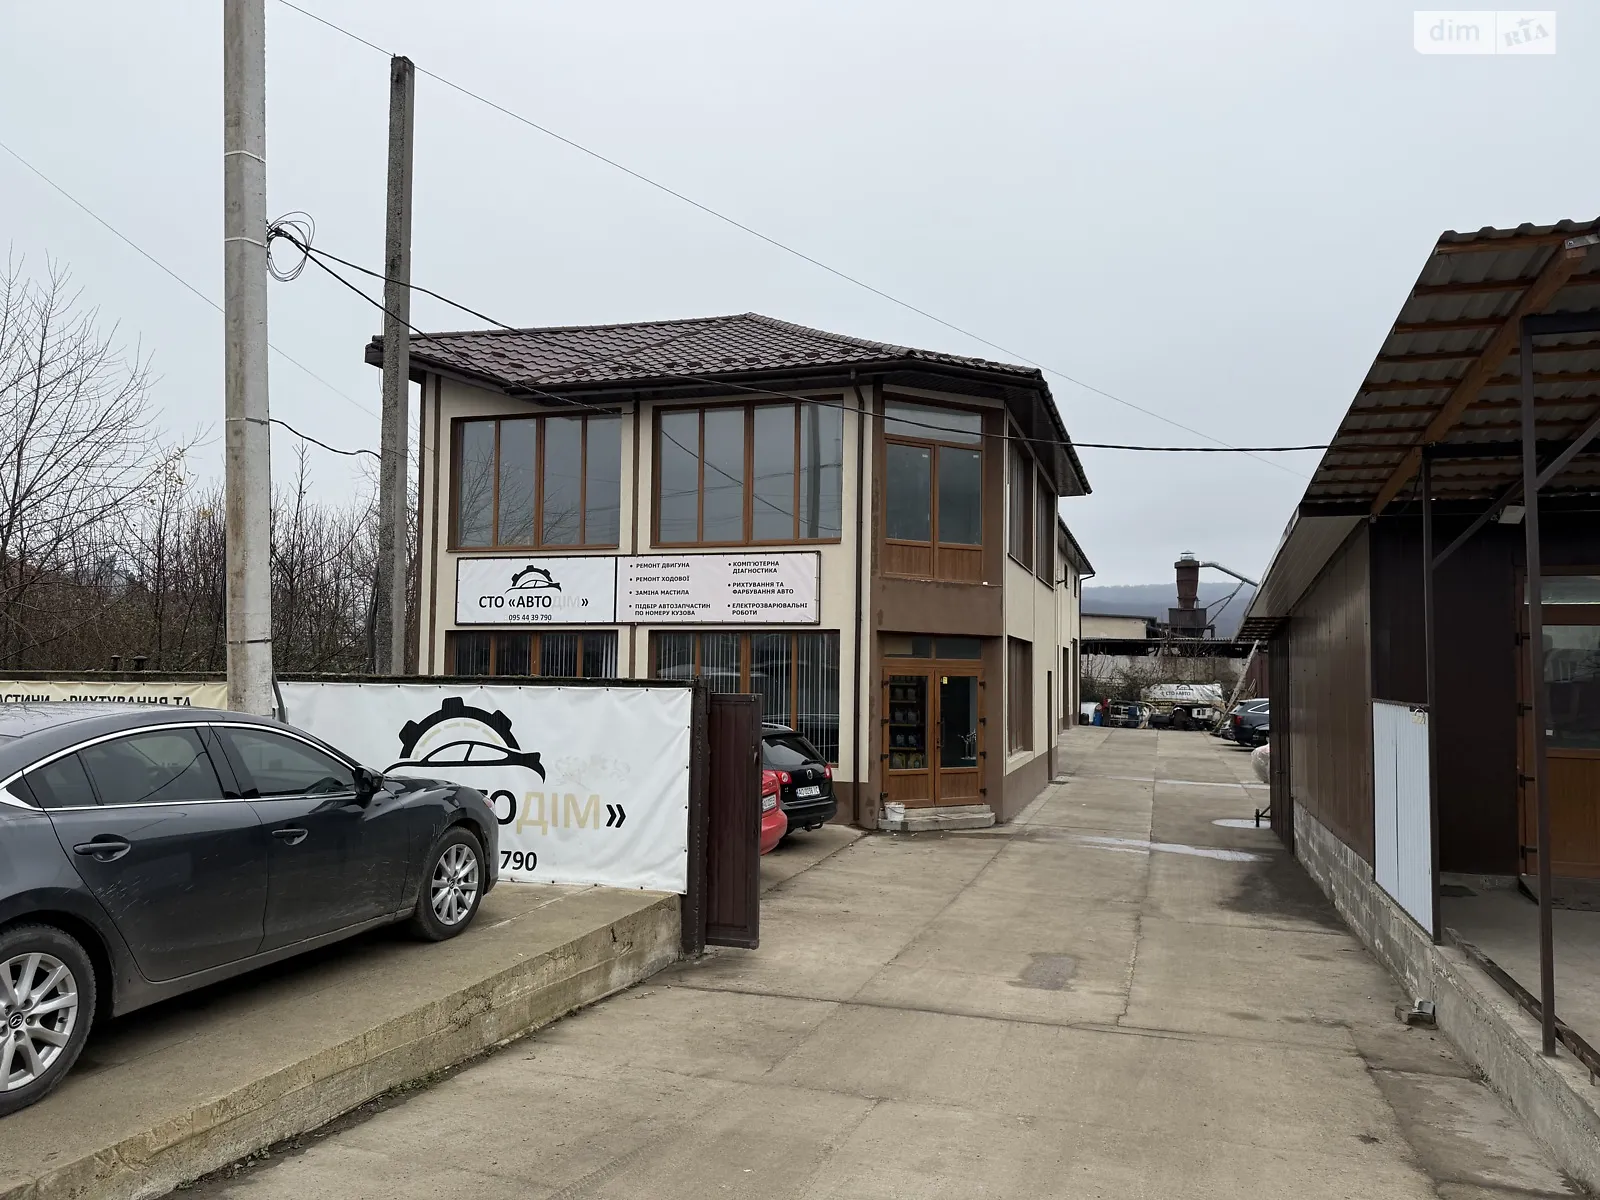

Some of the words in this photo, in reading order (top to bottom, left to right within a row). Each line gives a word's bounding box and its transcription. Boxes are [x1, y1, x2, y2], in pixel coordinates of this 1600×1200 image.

[478, 595, 505, 608] СТО
[477, 789, 627, 836] ОДІМ»
[499, 850, 538, 871] 790
